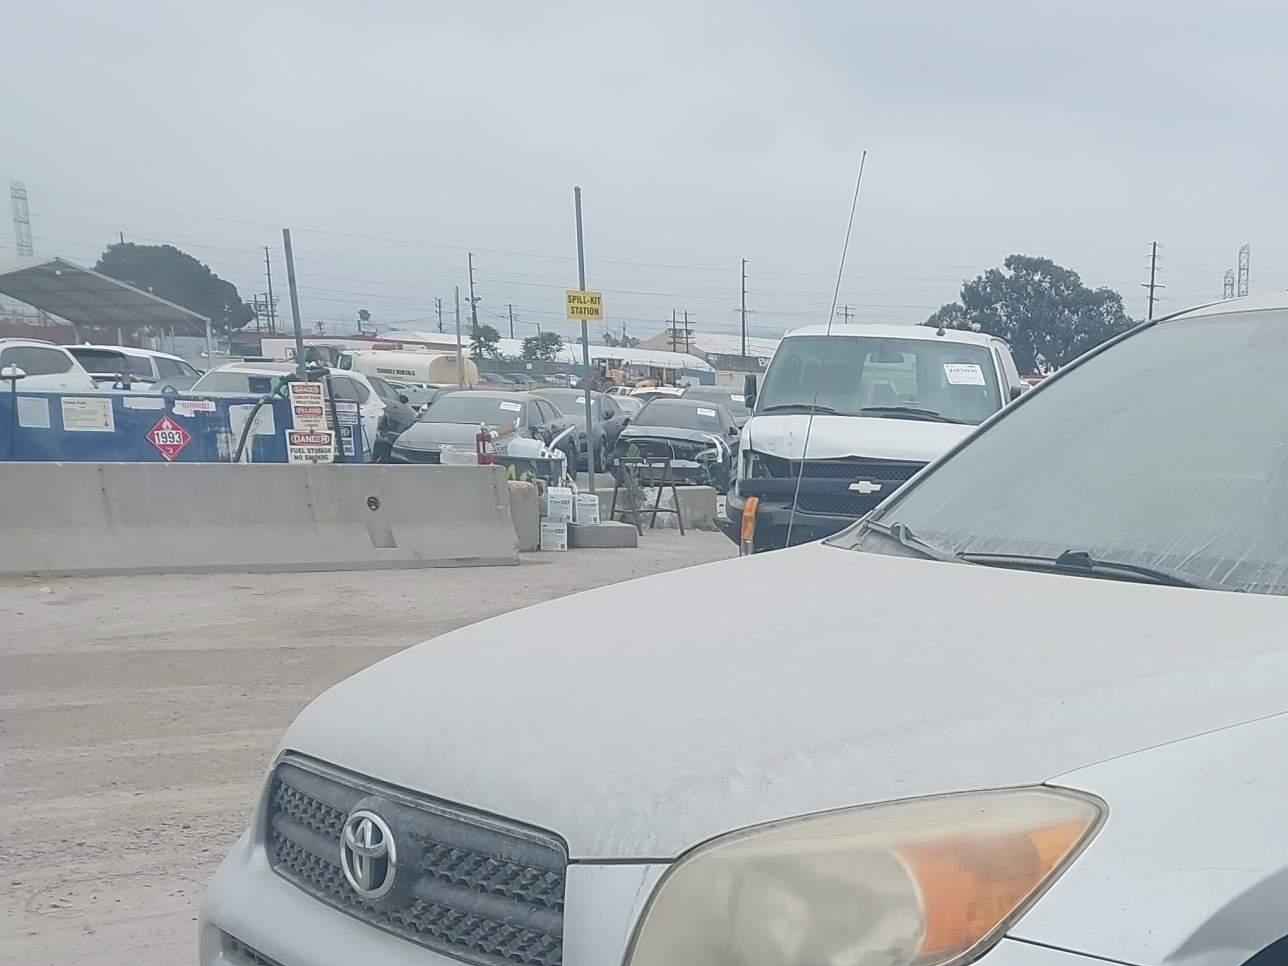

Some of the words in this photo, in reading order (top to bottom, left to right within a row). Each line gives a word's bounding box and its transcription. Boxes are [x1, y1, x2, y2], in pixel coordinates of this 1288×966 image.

[567, 295, 601, 304] SPILL-KIT
[571, 306, 599, 316] STATION
[155, 431, 182, 444] 1993
[293, 435, 329, 443] DANGER
